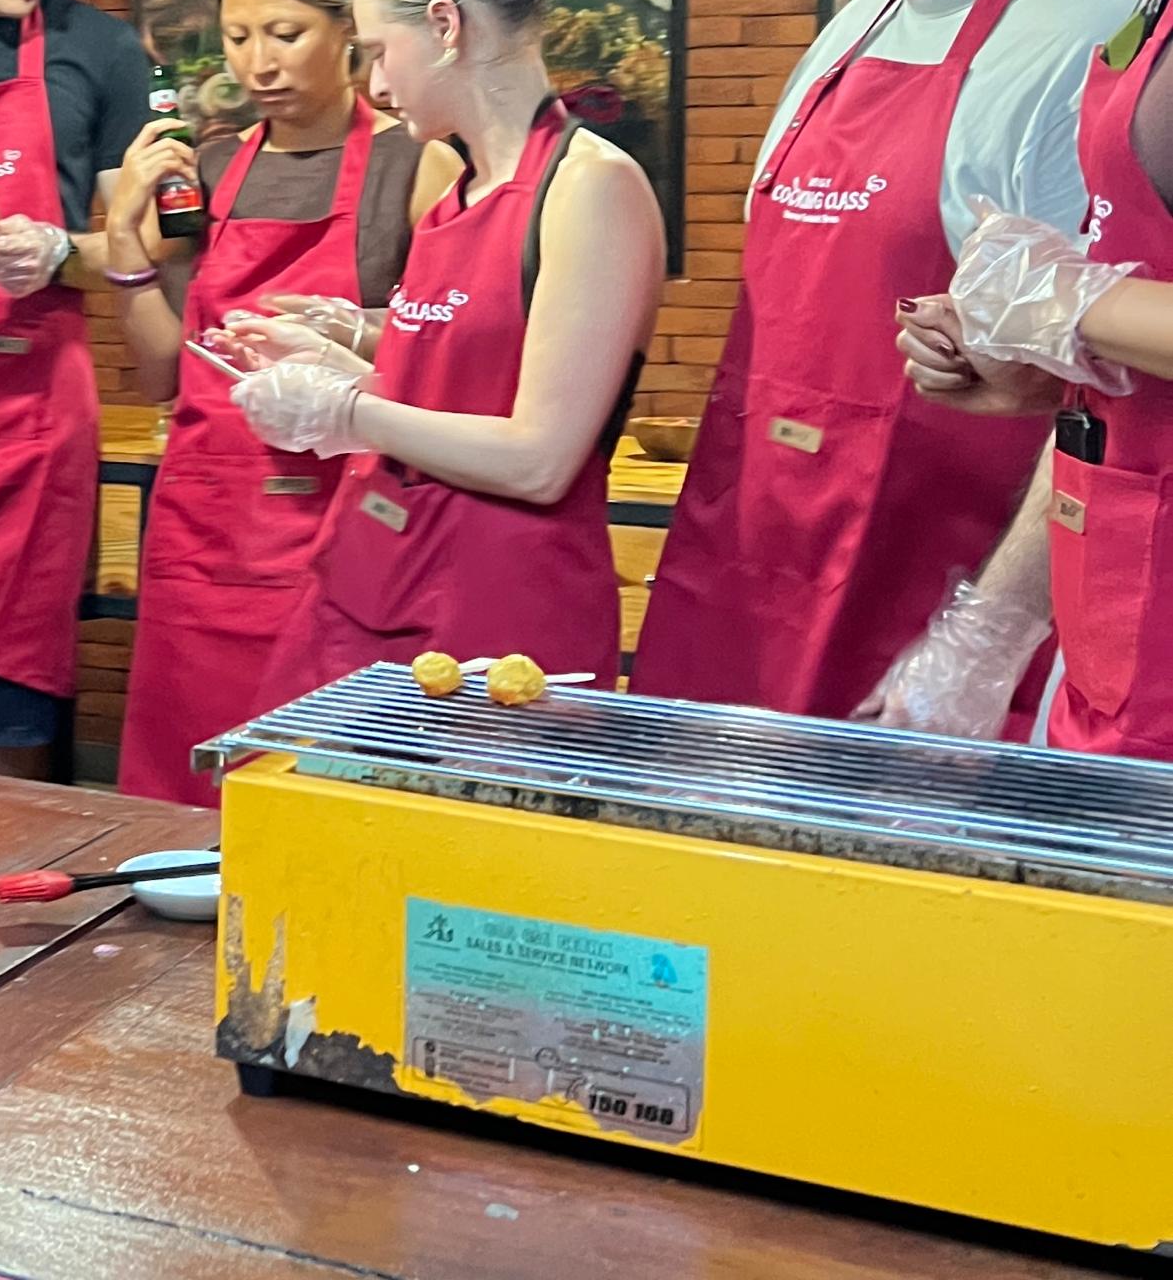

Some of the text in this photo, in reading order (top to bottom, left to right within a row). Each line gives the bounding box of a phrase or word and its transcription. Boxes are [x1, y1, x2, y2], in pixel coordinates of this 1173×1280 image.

[824, 190, 870, 211] CLASS
[401, 301, 455, 322] CLASS
[466, 936, 502, 955] SALES
[518, 946, 567, 966] SERVICE
[569, 955, 629, 975] NETWORK
